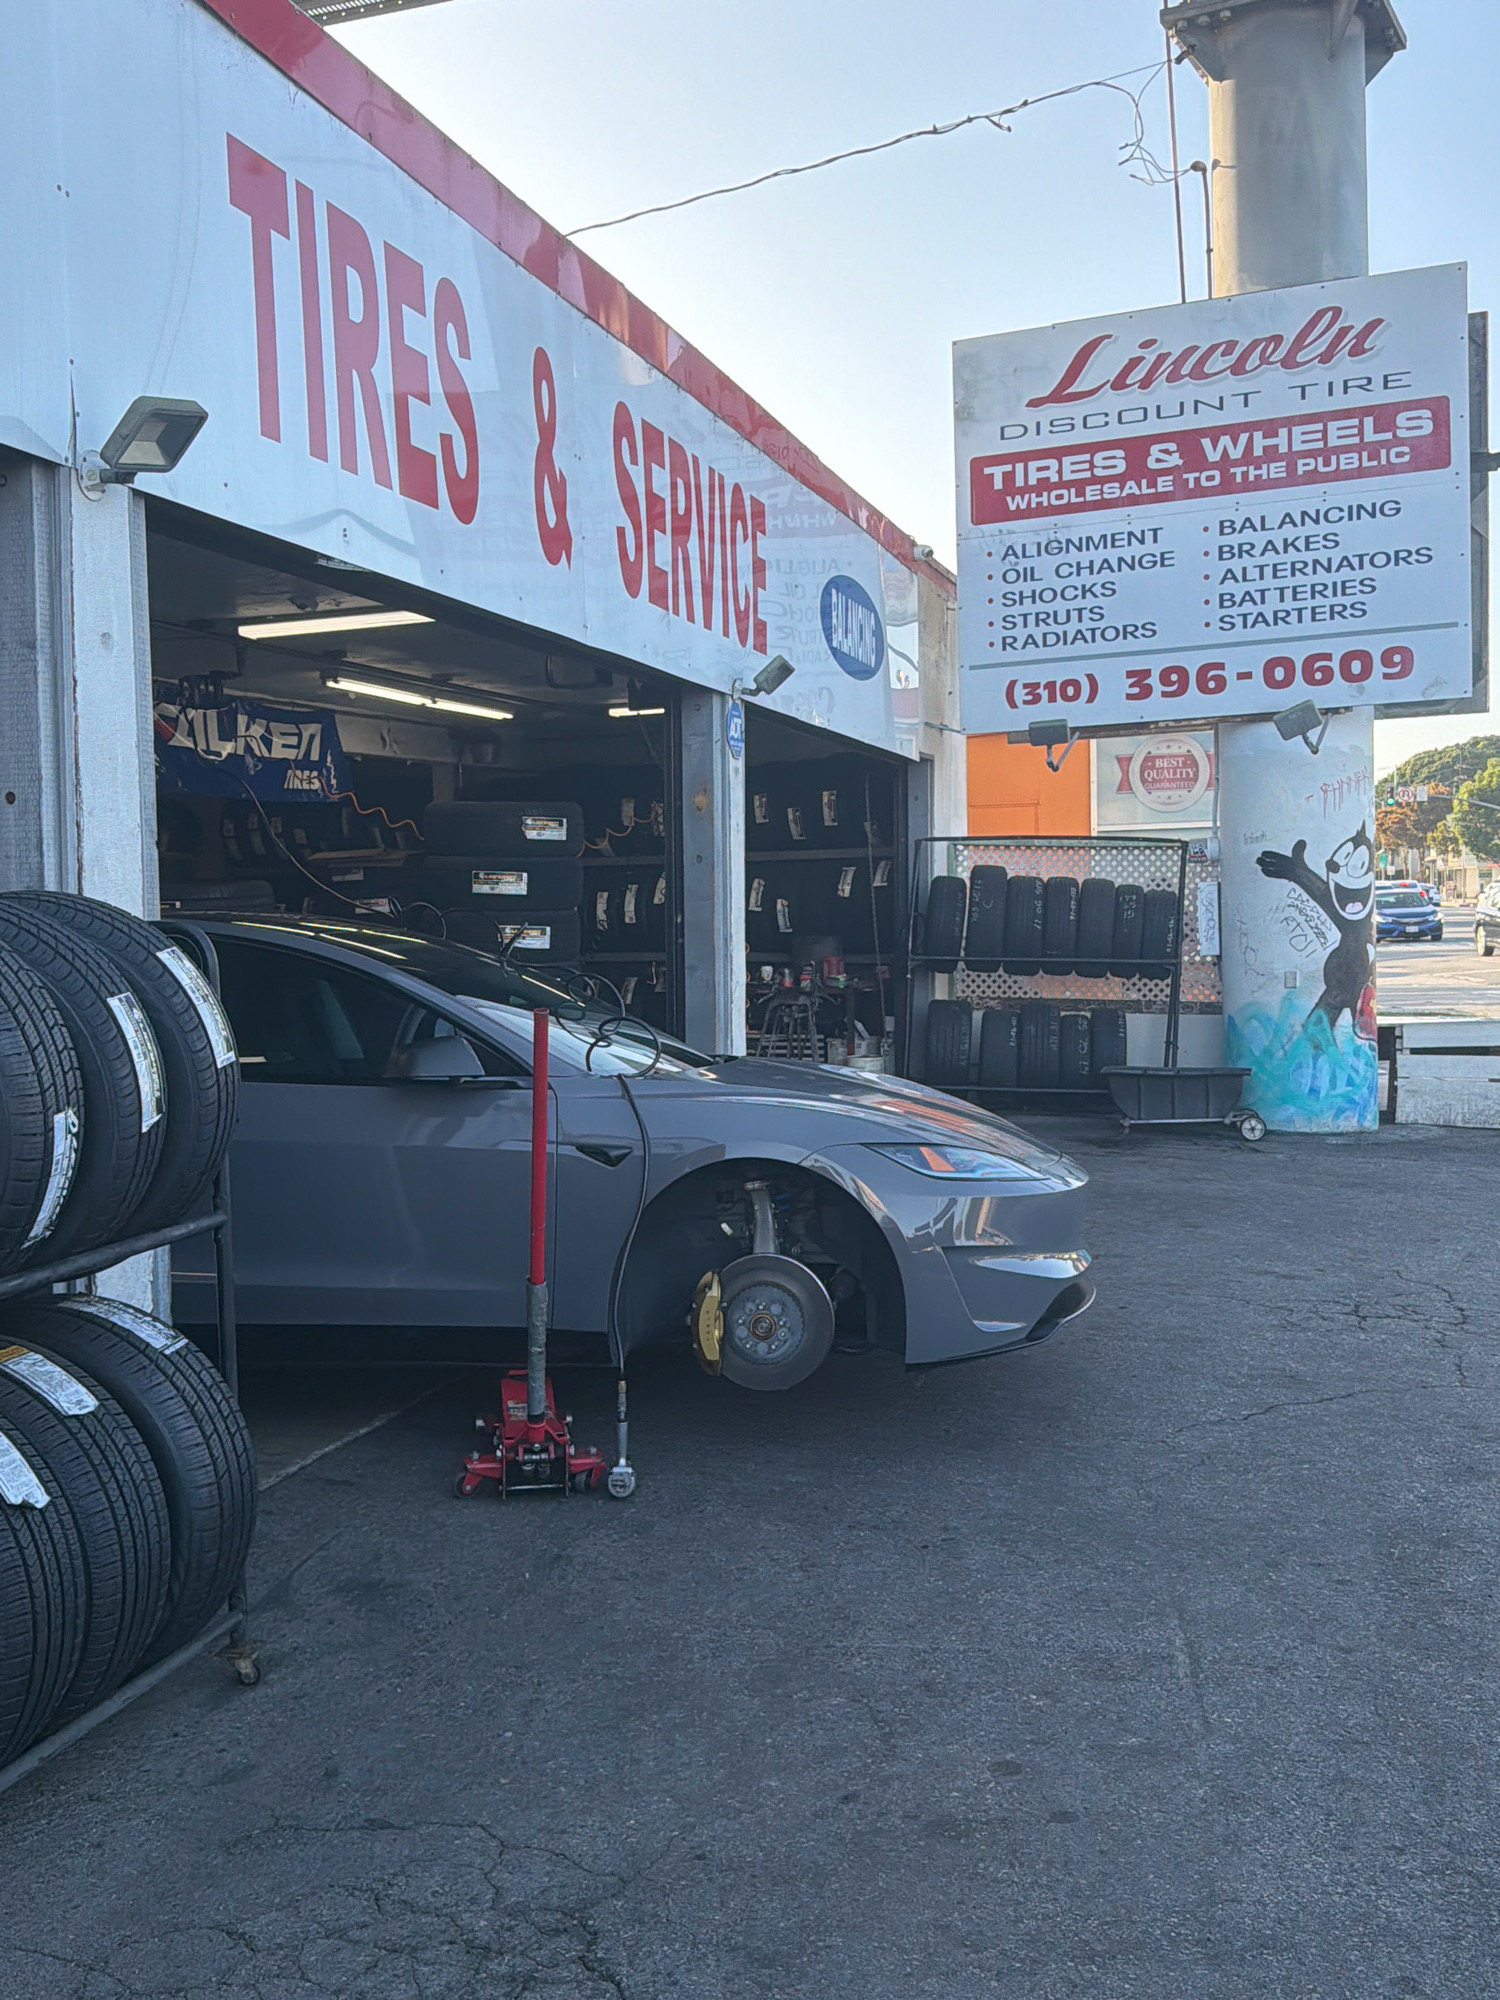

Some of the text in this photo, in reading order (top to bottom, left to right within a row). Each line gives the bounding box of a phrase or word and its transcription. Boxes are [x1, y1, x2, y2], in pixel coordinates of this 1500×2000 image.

[1025, 305, 1388, 409] Lincoln
[226, 132, 480, 525] TIRES
[532, 346, 573, 571] &
[612, 401, 767, 656] SERVICE
[1000, 371, 1413, 441] DISCOUNT TIRE
[983, 408, 1434, 491] TIRES & WHEELS
[1005, 445, 1411, 511] WHOLESALE TO THE PUBLIC
[1218, 499, 1402, 537] BALANCING
[1001, 526, 1164, 562] ALIGNMENT
[1217, 532, 1340, 562] BRAKES
[1001, 550, 1176, 585] OIL CHANGE
[1218, 546, 1434, 585] ALTERNATORS
[1001, 581, 1117, 608] SHOCKS
[1218, 576, 1377, 610] BATTERIES
[831, 587, 876, 669] BALANCING
[1001, 605, 1106, 632] STRUTS
[1218, 601, 1368, 632] STARTERS
[1001, 621, 1158, 652] RADIATORS
[1004, 645, 1415, 710] (310) 396-0609
[1144, 768, 1197, 782] QUALITY
[1155, 757, 1185, 768] BEST
[1144, 781, 1195, 790] GUARANTEED
